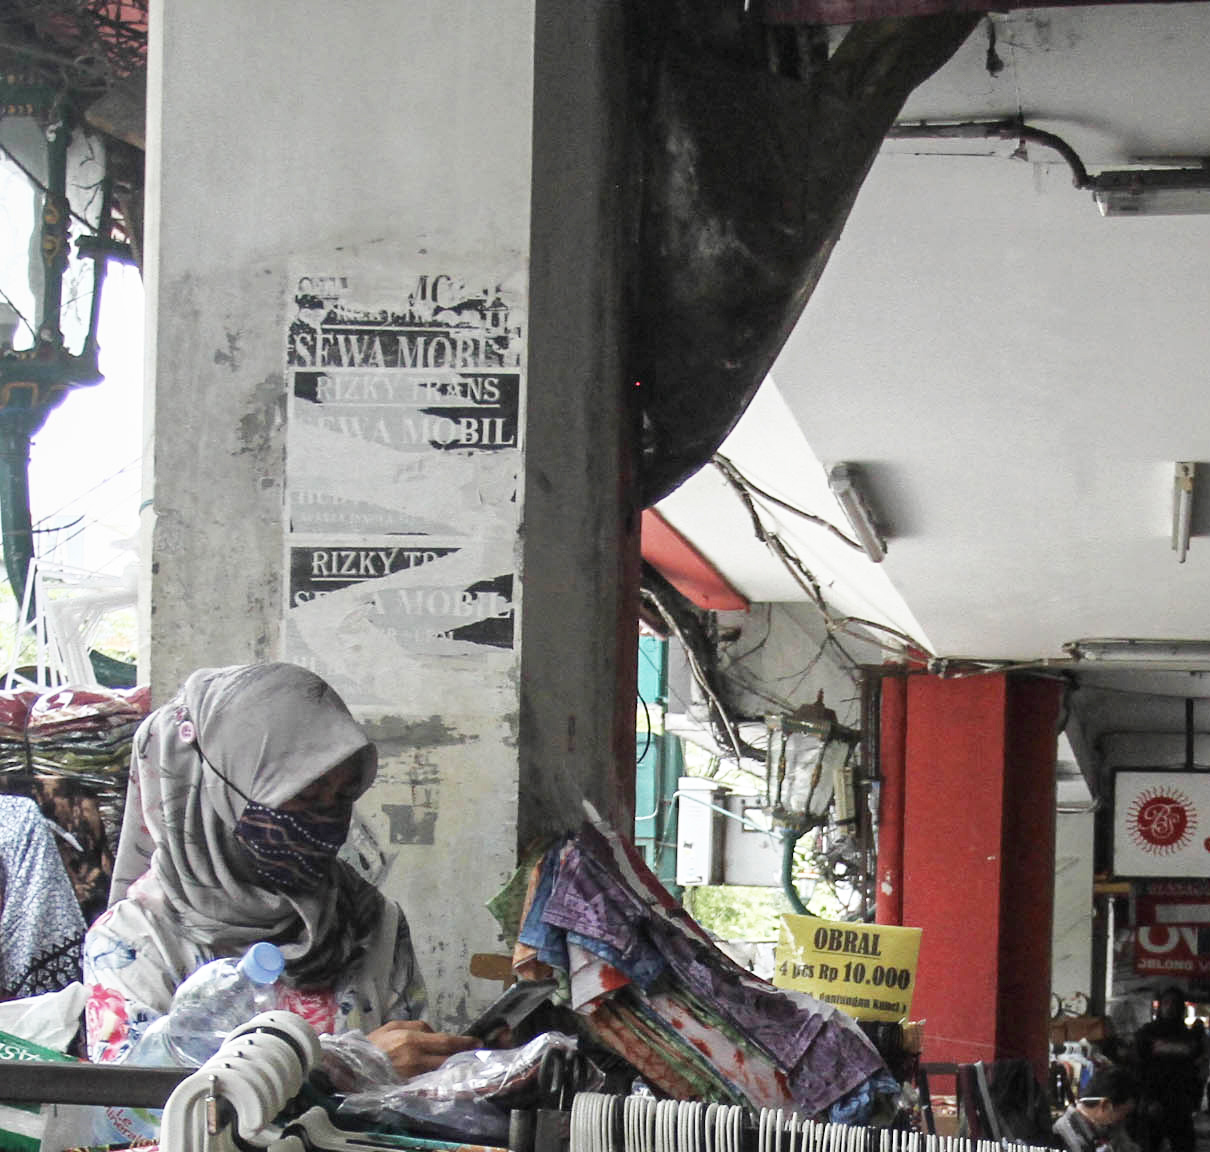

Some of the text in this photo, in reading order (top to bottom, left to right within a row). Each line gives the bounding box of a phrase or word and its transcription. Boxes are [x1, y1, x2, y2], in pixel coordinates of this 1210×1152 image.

[317, 376, 394, 401] RIZKY
[402, 418, 514, 445] MOBIL
[311, 548, 400, 577] RIZKY
[813, 927, 882, 957] OBRAL
[778, 960, 787, 976] 4
[818, 963, 838, 983] Rp
[842, 961, 910, 990] 10.000
